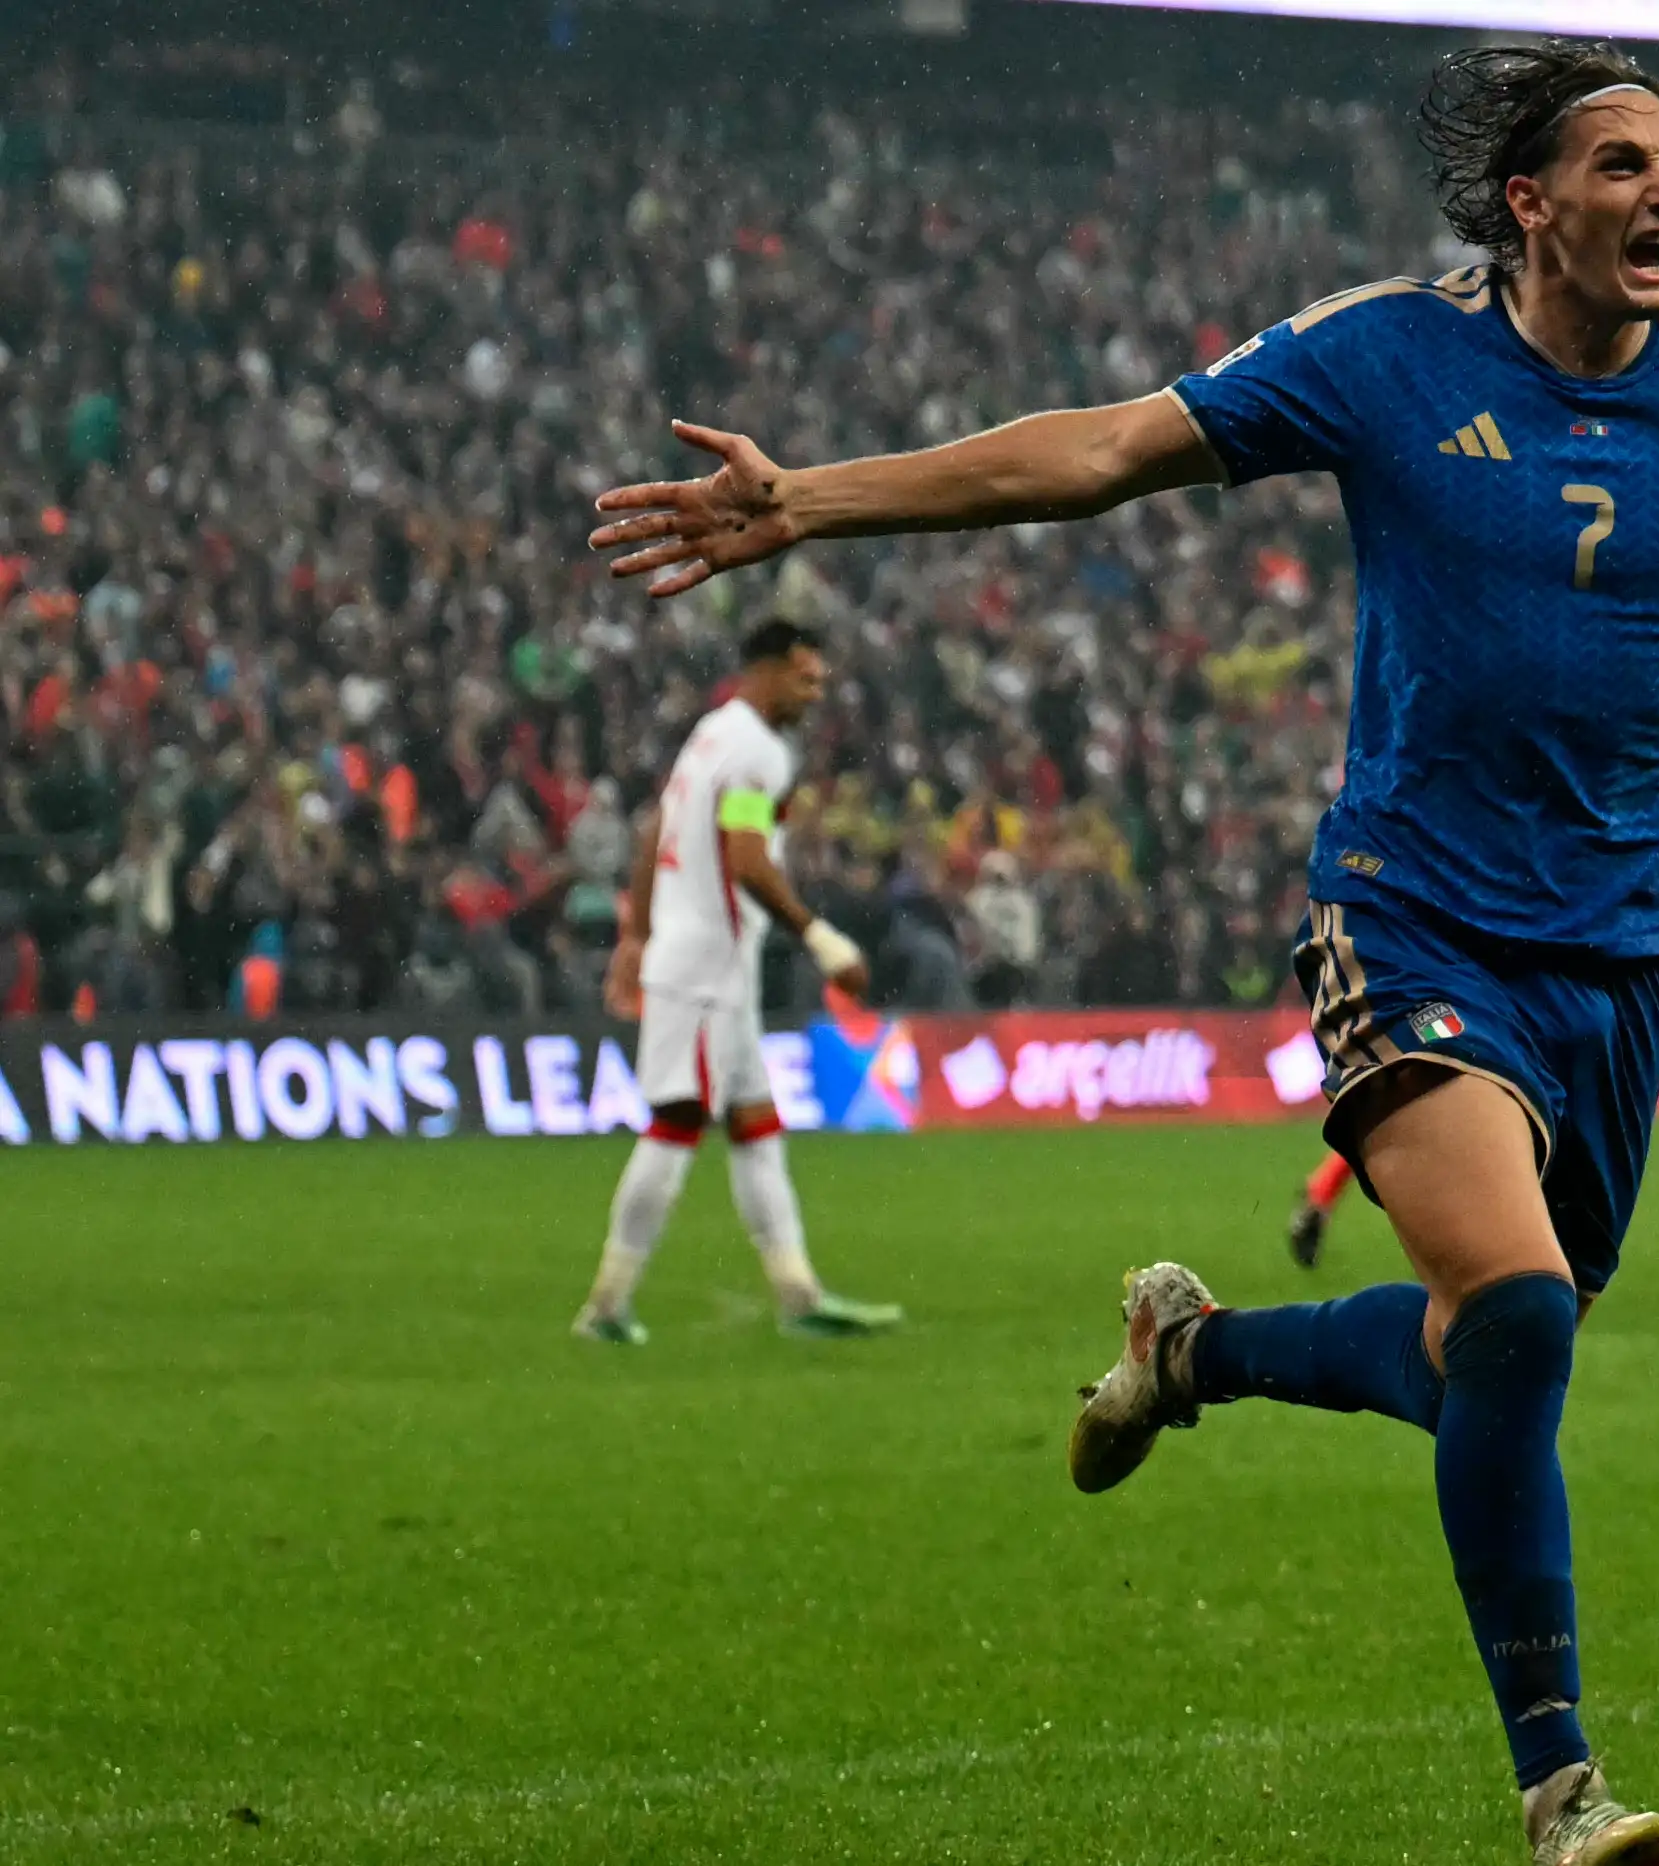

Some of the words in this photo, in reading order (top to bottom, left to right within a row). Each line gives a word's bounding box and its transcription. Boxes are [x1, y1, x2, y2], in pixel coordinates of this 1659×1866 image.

[1560, 483, 1615, 590] 7
[40, 1035, 459, 1145] NATIONS
[473, 1032, 825, 1137] LEAE
[1492, 1632, 1571, 1659] ITALIA
